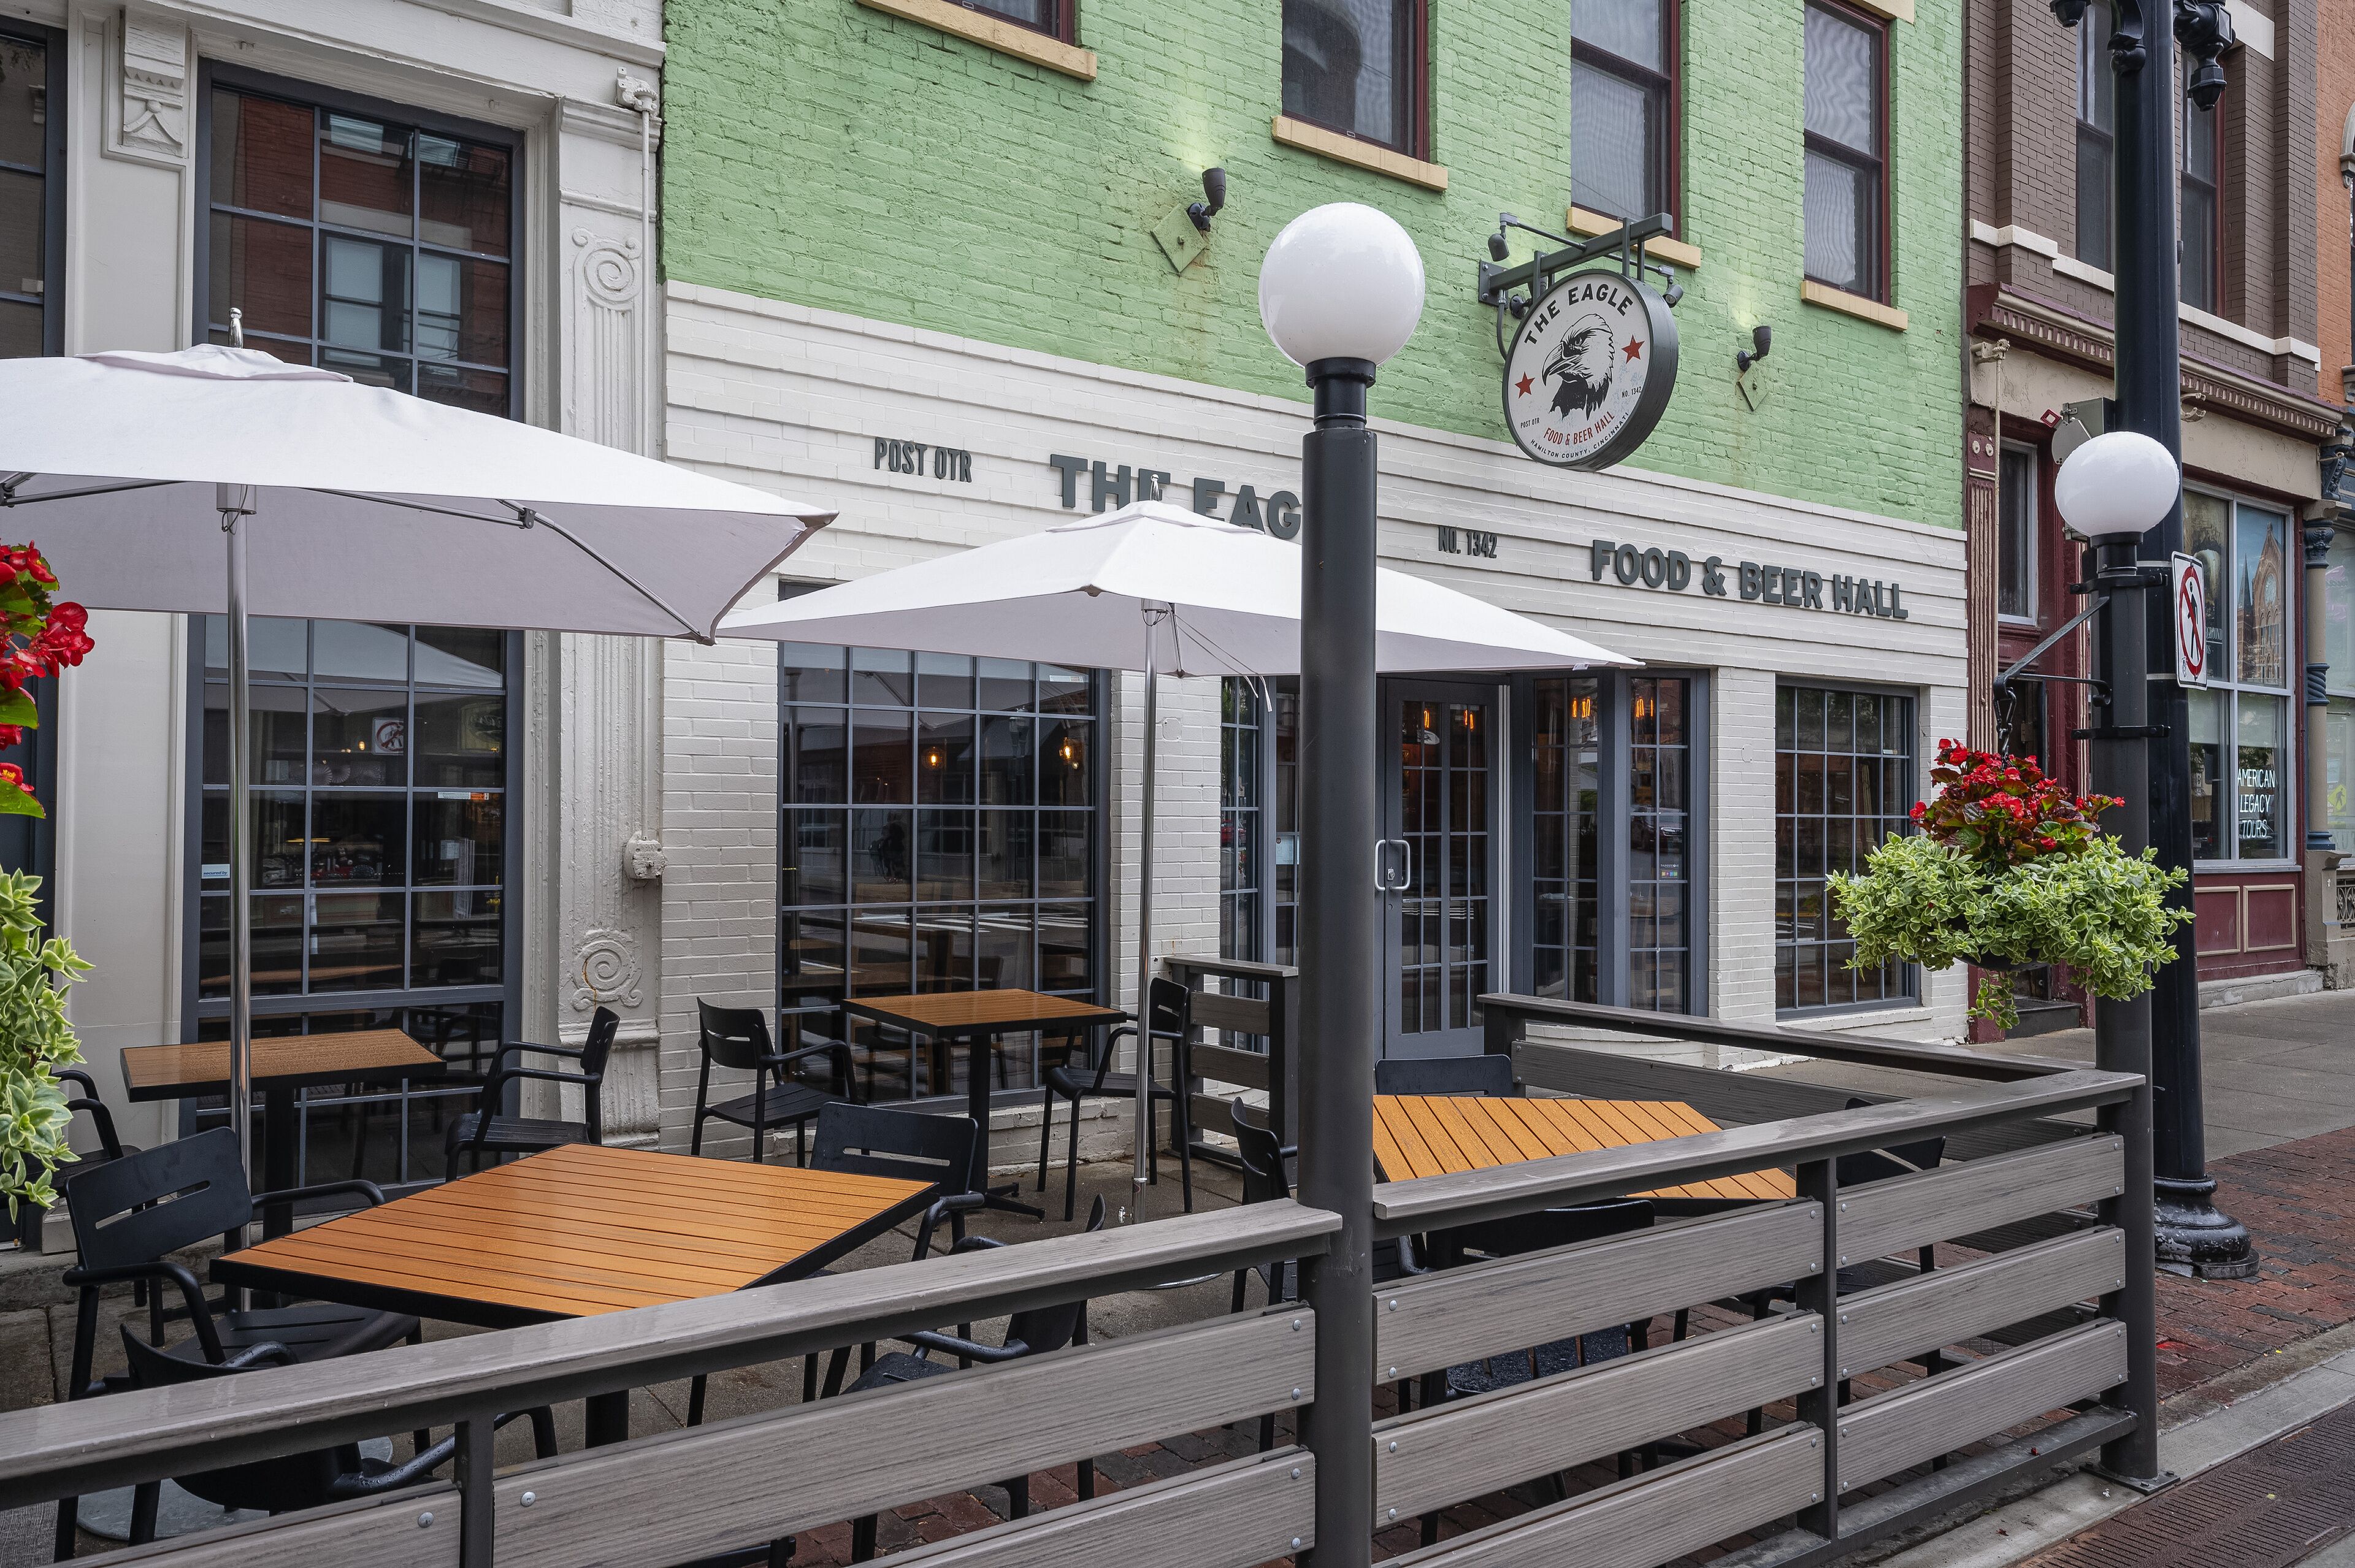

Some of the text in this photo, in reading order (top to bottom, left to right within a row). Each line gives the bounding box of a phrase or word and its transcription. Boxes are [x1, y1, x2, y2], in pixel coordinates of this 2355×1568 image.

[1524, 283, 1633, 345] THE EAGLE
[1631, 386, 1642, 395] 1342
[1520, 417, 1540, 429] POST OTR
[1530, 412, 1629, 459] HAMILTON COUNTY, CINCINNATI
[1544, 411, 1615, 446] FOOD & BEER HALL
[875, 436, 973, 483] POST OTR
[1049, 453, 1301, 539] THE EAG
[1438, 525, 1498, 559] NO. 1342
[1592, 538, 1909, 619] FOOD & BEER HALL
[2237, 768, 2275, 788] AMERICAN
[2239, 794, 2270, 813] LEGACY
[2242, 819, 2267, 838] TOURS
